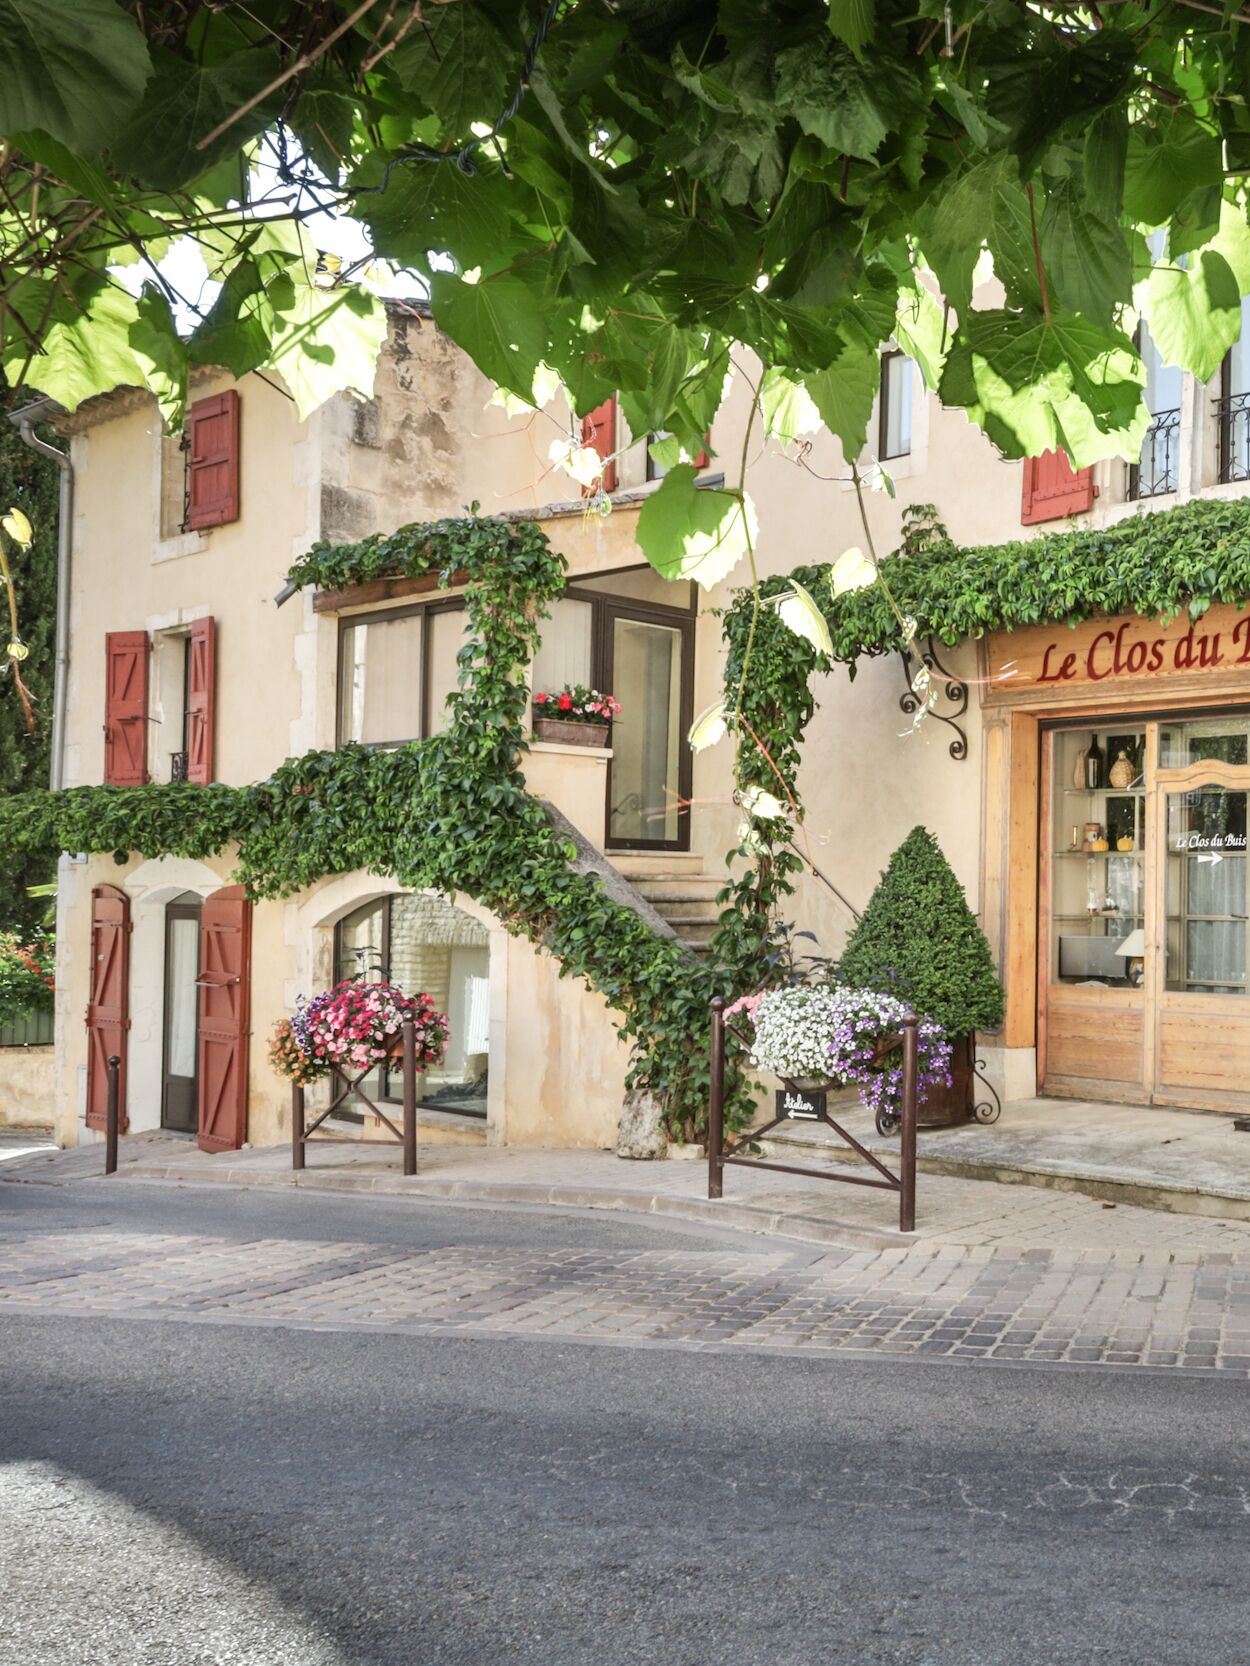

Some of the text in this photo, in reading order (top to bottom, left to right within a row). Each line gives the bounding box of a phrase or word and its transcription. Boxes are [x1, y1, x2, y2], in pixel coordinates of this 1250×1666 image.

[1037, 644, 1077, 682] Le
[1086, 622, 1164, 680] Clos
[1174, 614, 1224, 669] du
[1176, 833, 1247, 848] Le Clos du Buis
[783, 1092, 814, 1111] Atelier
